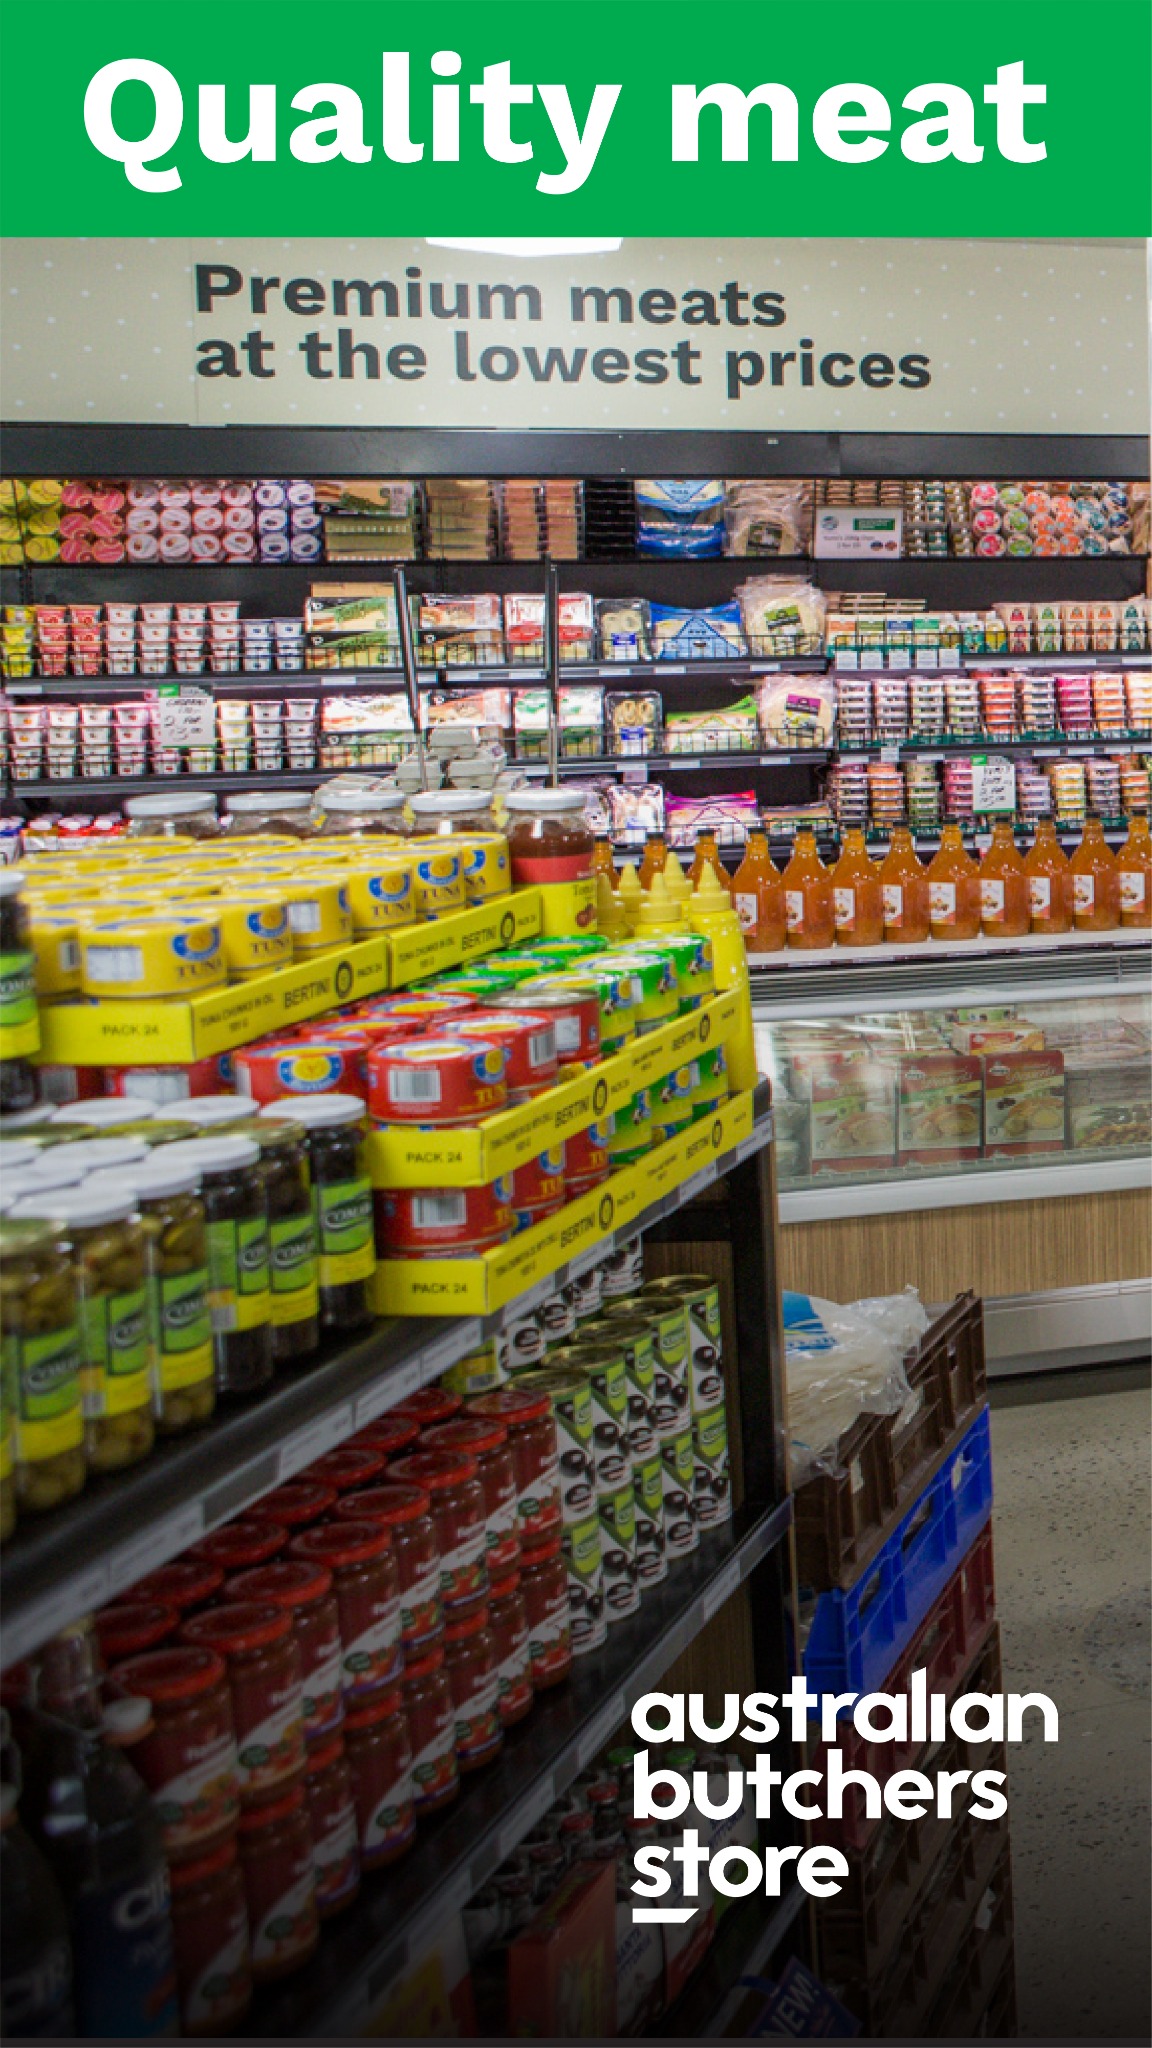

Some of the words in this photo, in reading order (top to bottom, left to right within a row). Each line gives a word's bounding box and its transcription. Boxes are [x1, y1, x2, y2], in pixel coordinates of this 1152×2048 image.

[195, 264, 543, 321] Premium
[570, 278, 787, 328] meats
[196, 331, 276, 379] at
[298, 332, 427, 380] the
[454, 332, 701, 385] lowest
[725, 340, 932, 400] prices
[284, 977, 331, 1009] BERTINI
[102, 1024, 139, 1037] PACK
[143, 1023, 159, 1036] 24
[554, 1095, 590, 1129] BERTINI
[405, 1151, 443, 1164] PACK
[446, 1150, 463, 1164] 24
[561, 1213, 597, 1249] BERTINI
[410, 1281, 449, 1295] PACK
[452, 1281, 468, 1294] 24
